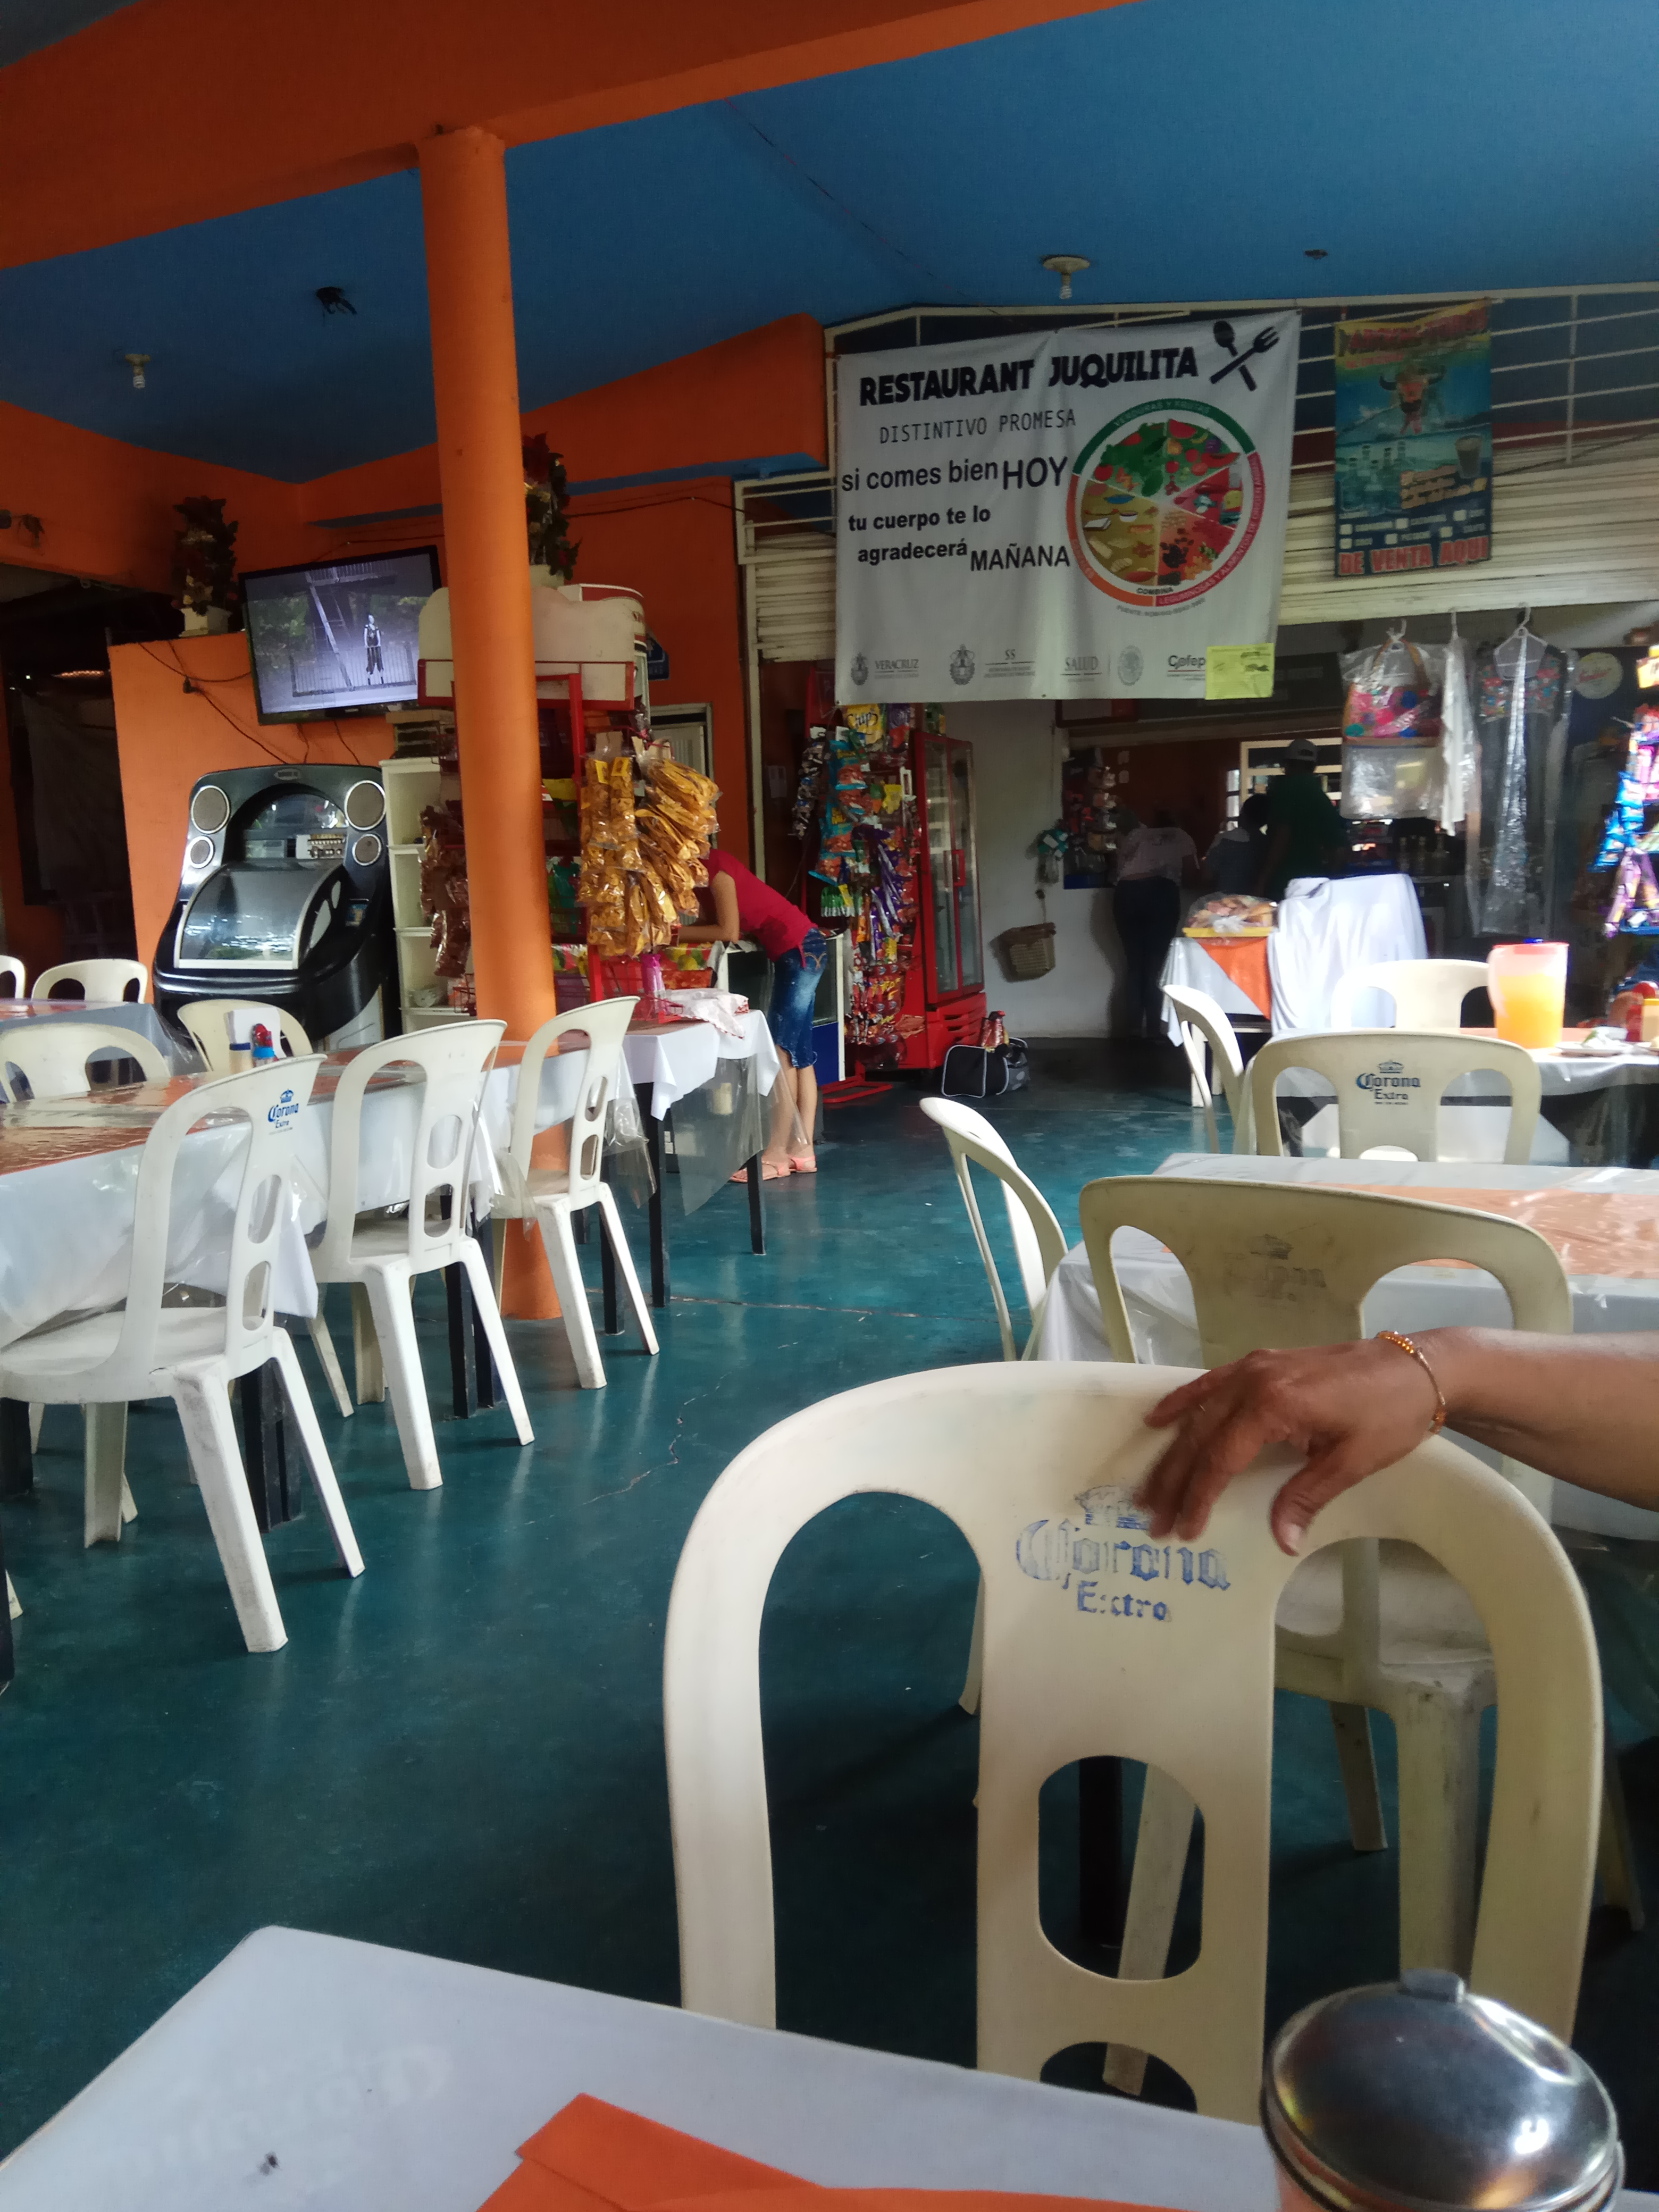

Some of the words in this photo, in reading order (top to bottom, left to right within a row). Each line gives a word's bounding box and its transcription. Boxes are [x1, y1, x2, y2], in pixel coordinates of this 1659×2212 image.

[859, 359, 1035, 406] RESTAURANT
[1048, 347, 1199, 389] JUQUILITA
[879, 417, 987, 444] DISTINTIVO
[998, 409, 1076, 432] PROMESA
[841, 468, 860, 491] si
[866, 466, 942, 490] comes
[949, 458, 999, 483] bien
[1002, 456, 1068, 490] HOY
[848, 514, 867, 531] tu
[873, 512, 941, 531] cuerpo
[946, 507, 967, 525] te
[973, 505, 992, 523] lo
[857, 538, 968, 566] agradecerá
[970, 542, 1070, 572] MAÑANA
[1339, 551, 1364, 576] DE
[1370, 543, 1434, 573] VENTA
[1065, 656, 1099, 672] SALUD
[1355, 1072, 1421, 1091] Corona
[1374, 1088, 1409, 1100] Extra
[267, 1103, 299, 1122] Corona
[1016, 1518, 1231, 1591] Corona
